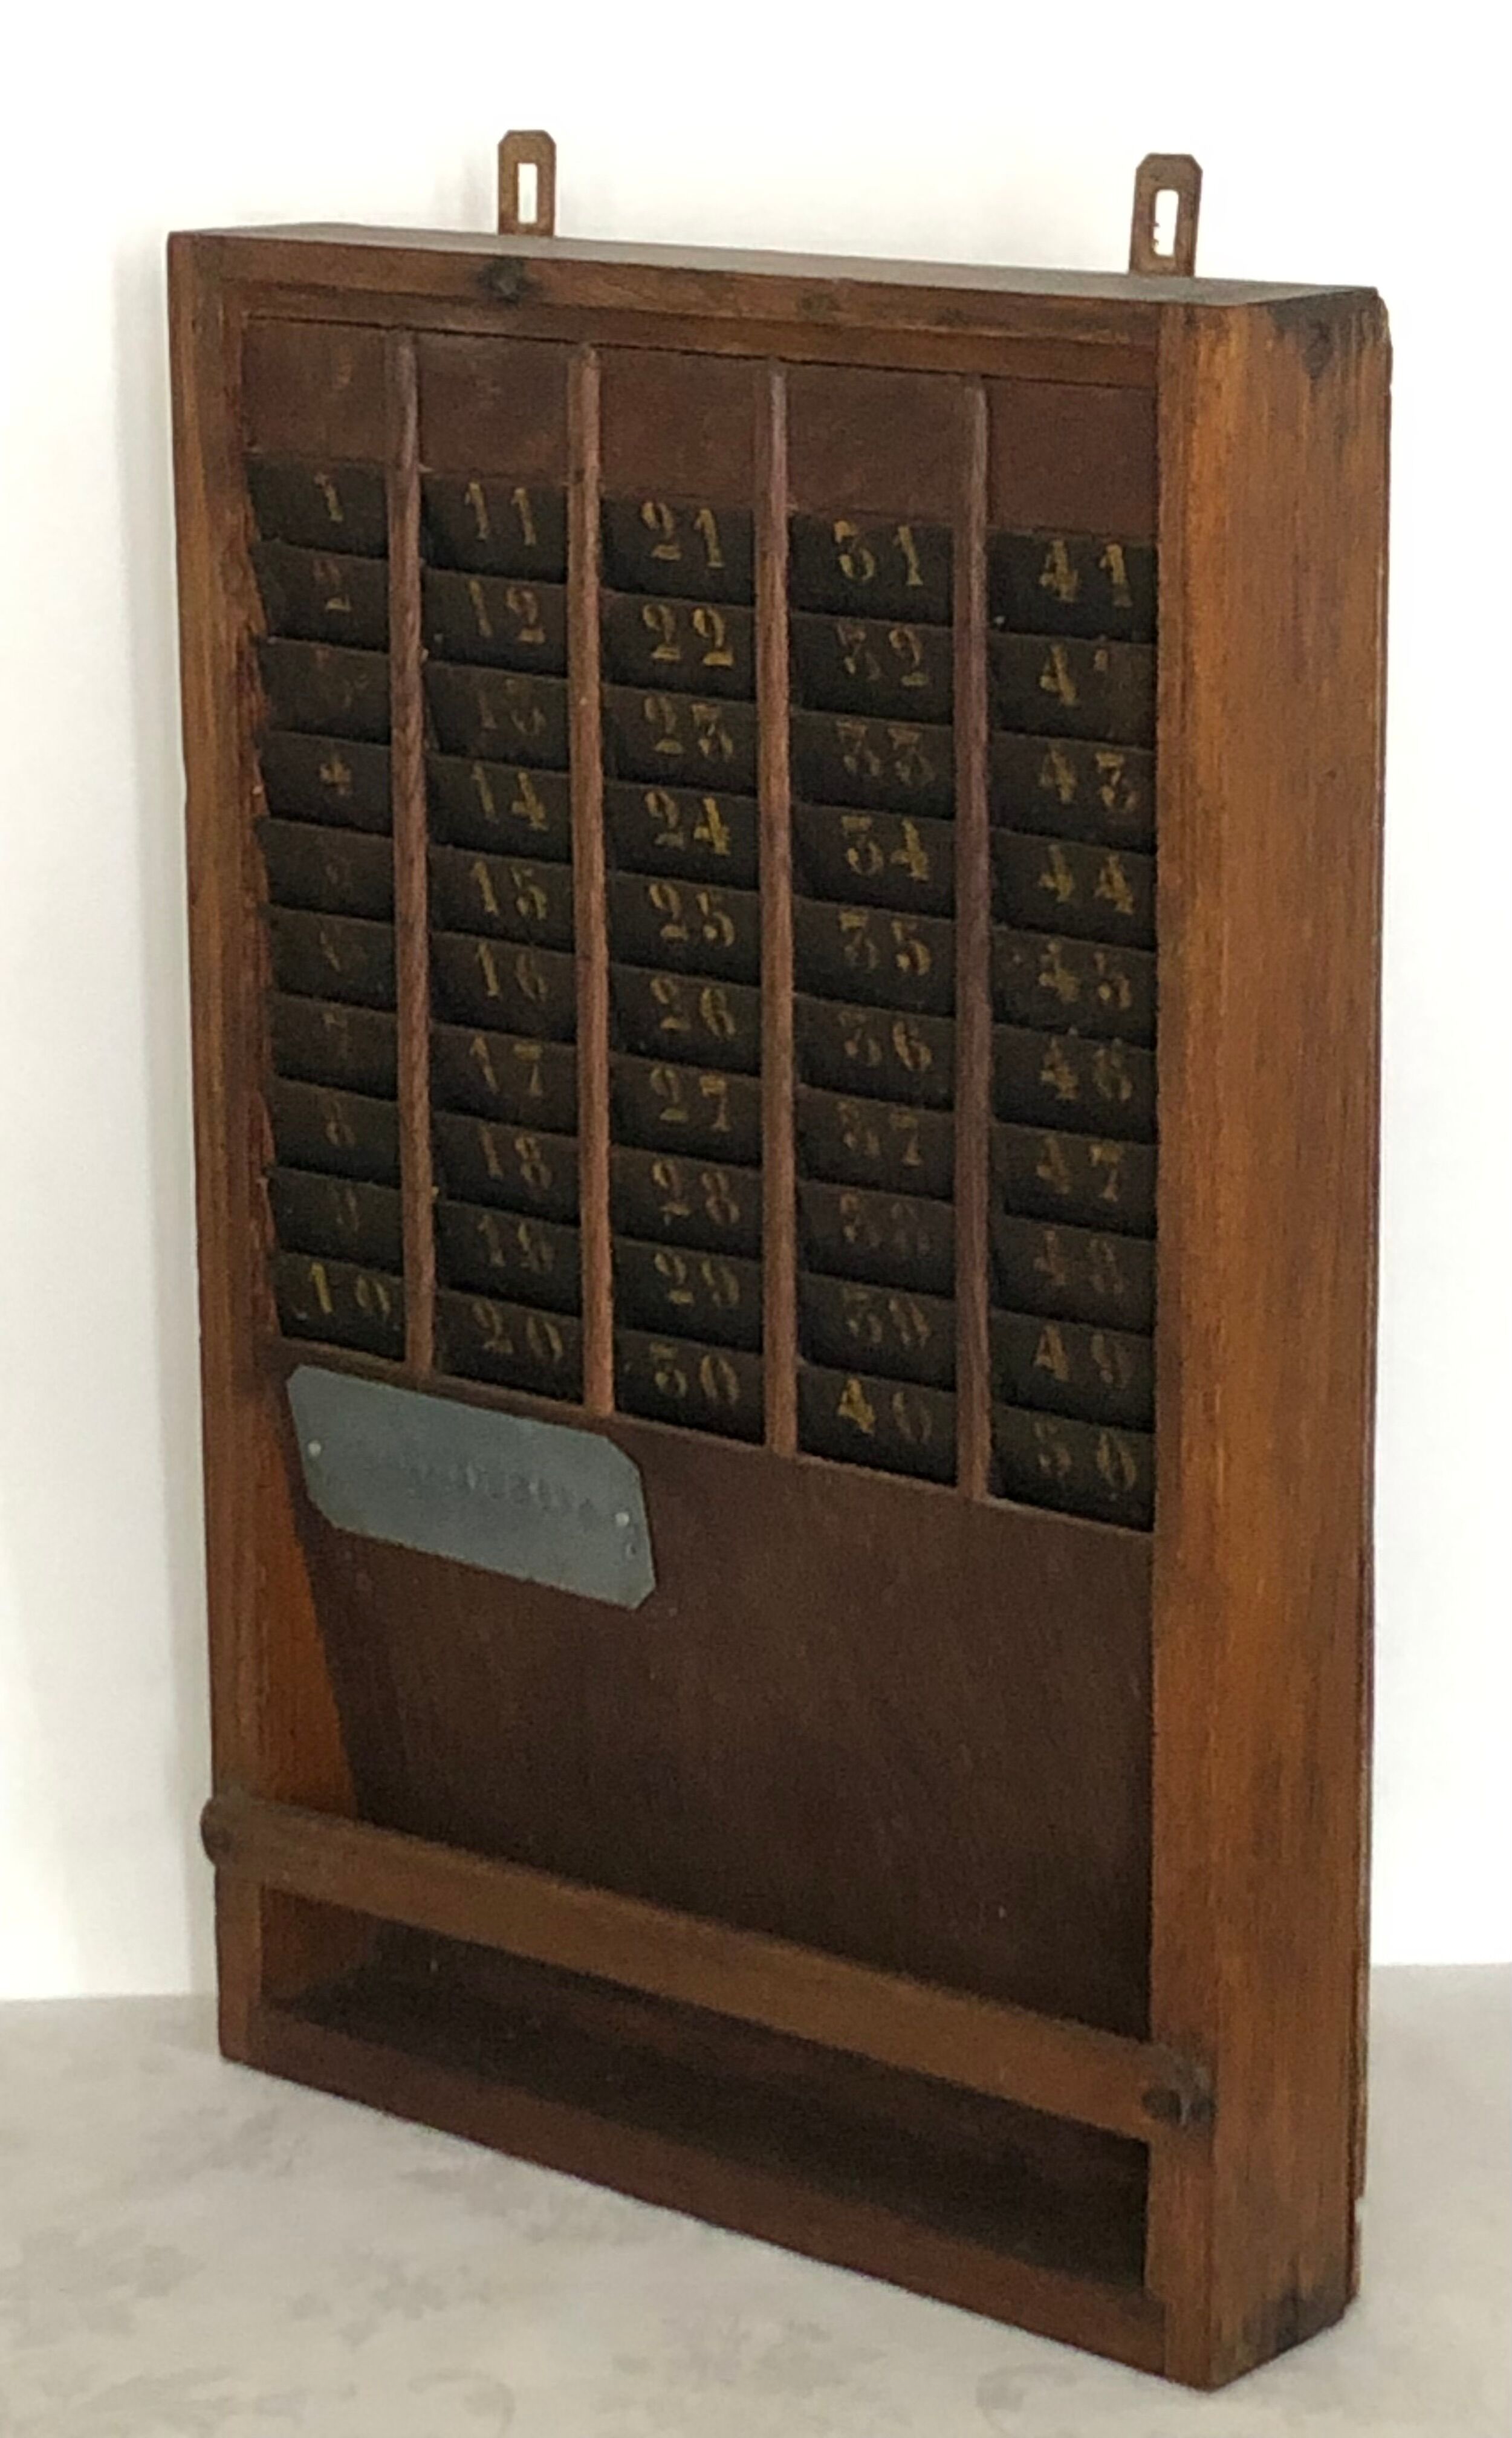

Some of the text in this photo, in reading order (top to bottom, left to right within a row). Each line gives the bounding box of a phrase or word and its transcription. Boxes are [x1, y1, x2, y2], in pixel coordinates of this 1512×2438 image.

[315, 473, 343, 522] 1
[465, 482, 536, 545] 11
[641, 502, 725, 568] 21
[1039, 540, 1132, 606] 41
[468, 579, 545, 643] 12
[642, 605, 734, 666] 22
[472, 764, 548, 831] 14
[644, 791, 730, 856] 24
[841, 814, 929, 882] 34
[1038, 845, 1134, 915] 44
[471, 859, 546, 920] 15
[649, 882, 735, 948] 25
[470, 1035, 543, 1097] 17
[650, 1067, 730, 1131] 27
[479, 1123, 553, 1188] 18
[1036, 1136, 1124, 1202] 47
[310, 1262, 392, 1319] 10
[473, 1299, 563, 1361] 20
